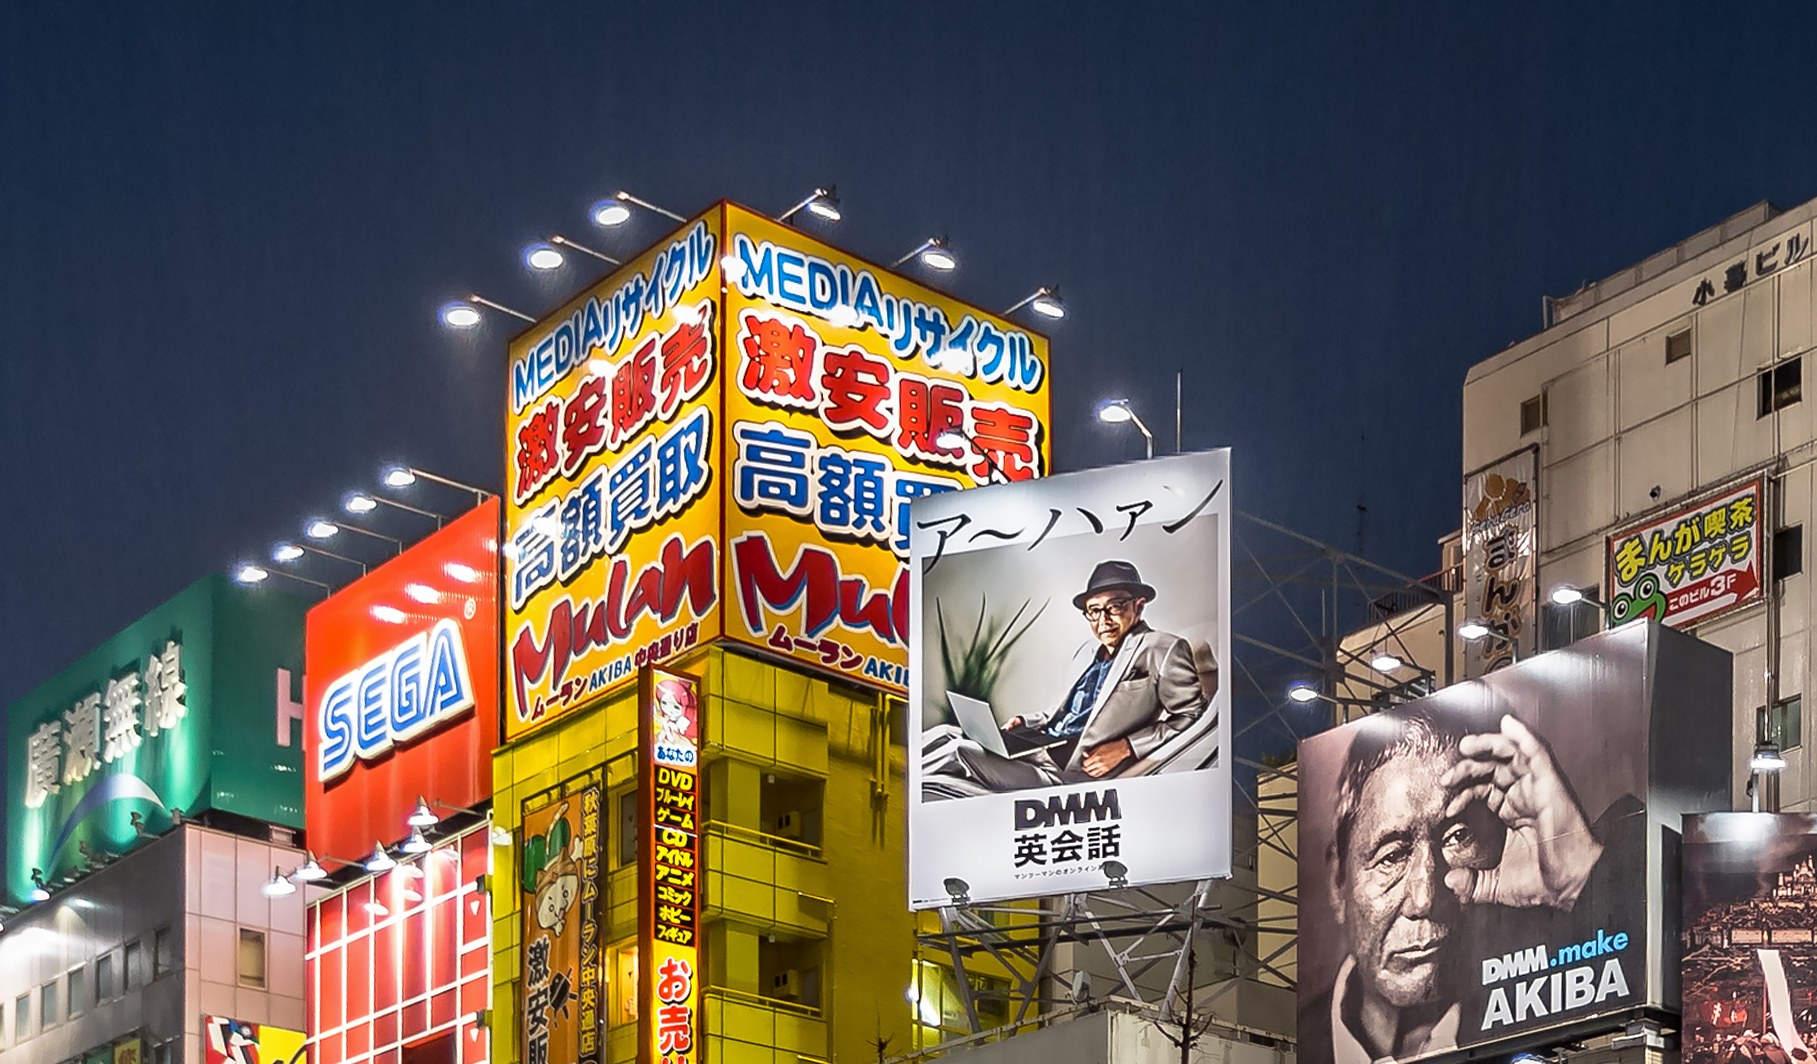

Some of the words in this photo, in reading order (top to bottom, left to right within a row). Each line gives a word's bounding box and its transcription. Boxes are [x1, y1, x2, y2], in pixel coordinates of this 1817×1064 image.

[735, 234, 1041, 391] MEDIAリサイクル
[515, 320, 712, 500] 激安販売
[740, 309, 1039, 482] 激安販売
[513, 412, 709, 602] 高額買取
[1616, 496, 1755, 583] まんが喫茶
[1667, 534, 1752, 586] ゲラゲラ
[513, 538, 717, 722] Mulan
[321, 622, 473, 780] SEGA
[655, 744, 696, 766] あなたの
[656, 788, 695, 811] ブルーレイ
[657, 769, 694, 791] DVD
[656, 807, 695, 830] ゲーム
[1014, 788, 1122, 831] DMM
[655, 846, 695, 868] アイドル
[661, 827, 688, 849] CD
[1014, 824, 1122, 867] 英会話
[655, 866, 694, 889] アニメ
[657, 888, 693, 909] コミック
[658, 904, 693, 925] ホビー
[1481, 957, 1630, 1032] AKIBA
